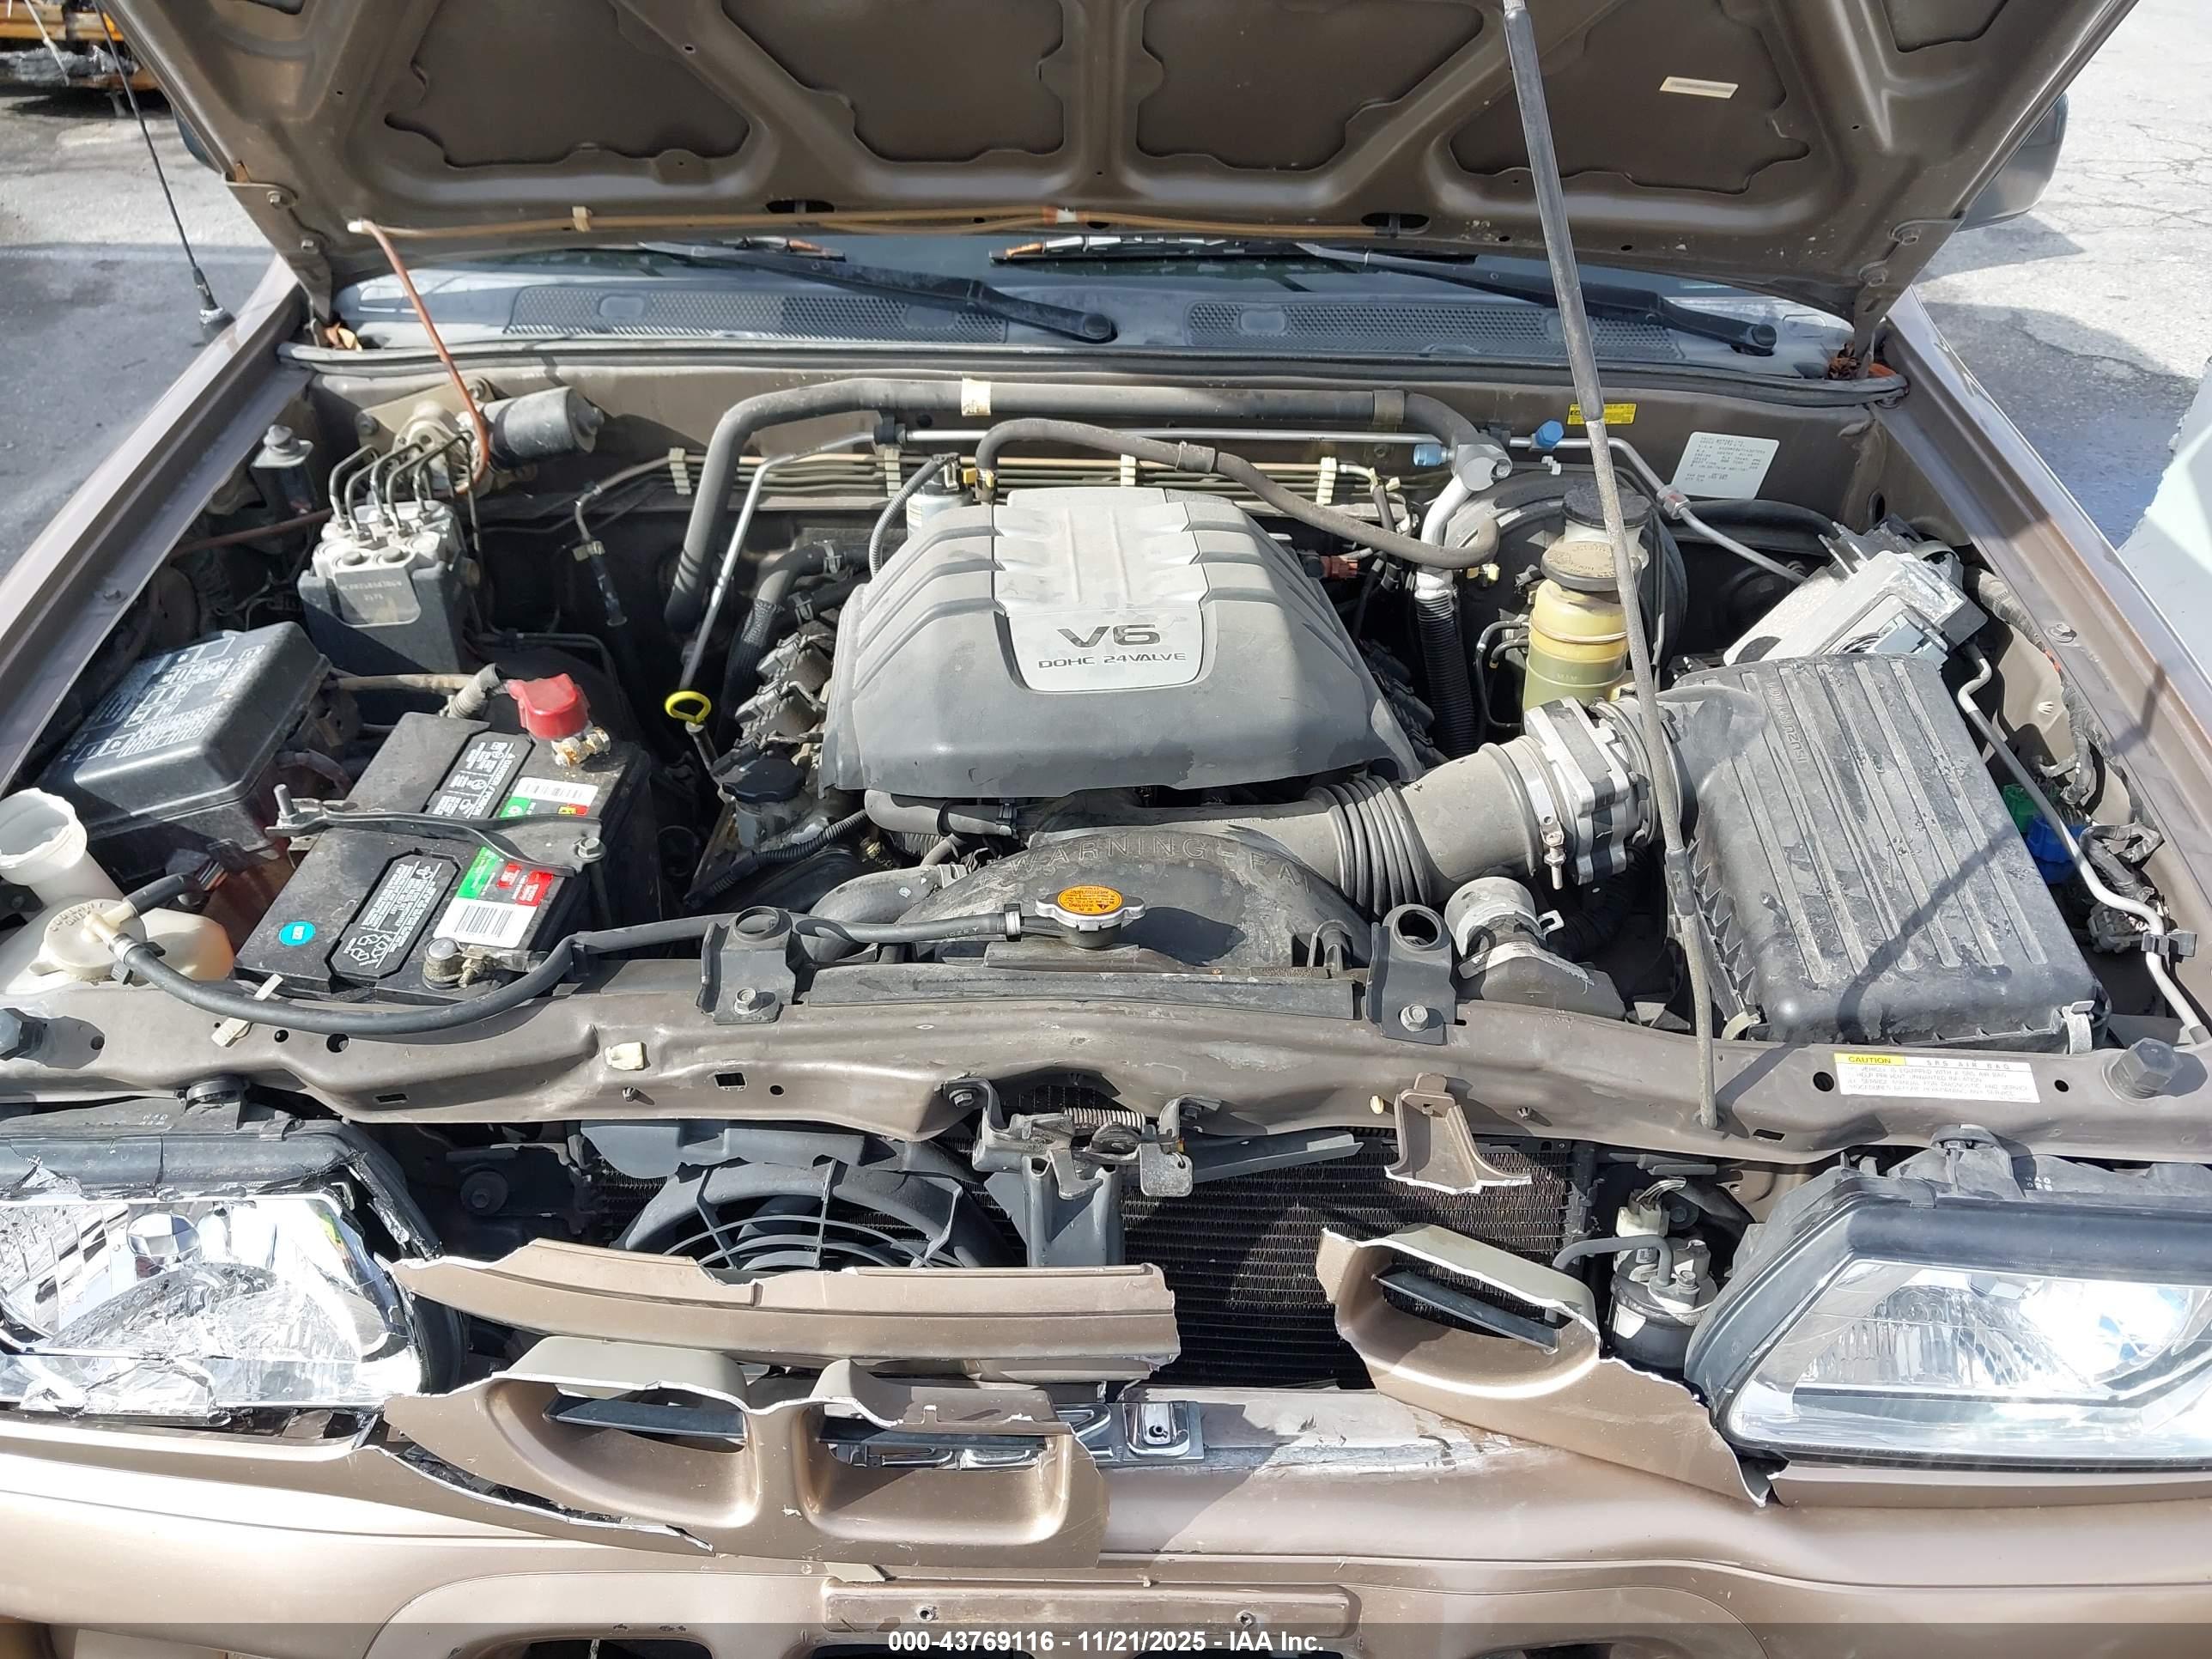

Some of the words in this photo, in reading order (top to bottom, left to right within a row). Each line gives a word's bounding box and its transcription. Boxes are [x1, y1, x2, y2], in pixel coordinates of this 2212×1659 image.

[1057, 623, 1161, 647] V6
[1038, 656, 1095, 669] DOHC
[1103, 653, 1186, 663] 24VALVE
[1008, 836, 1207, 876] WARNING
